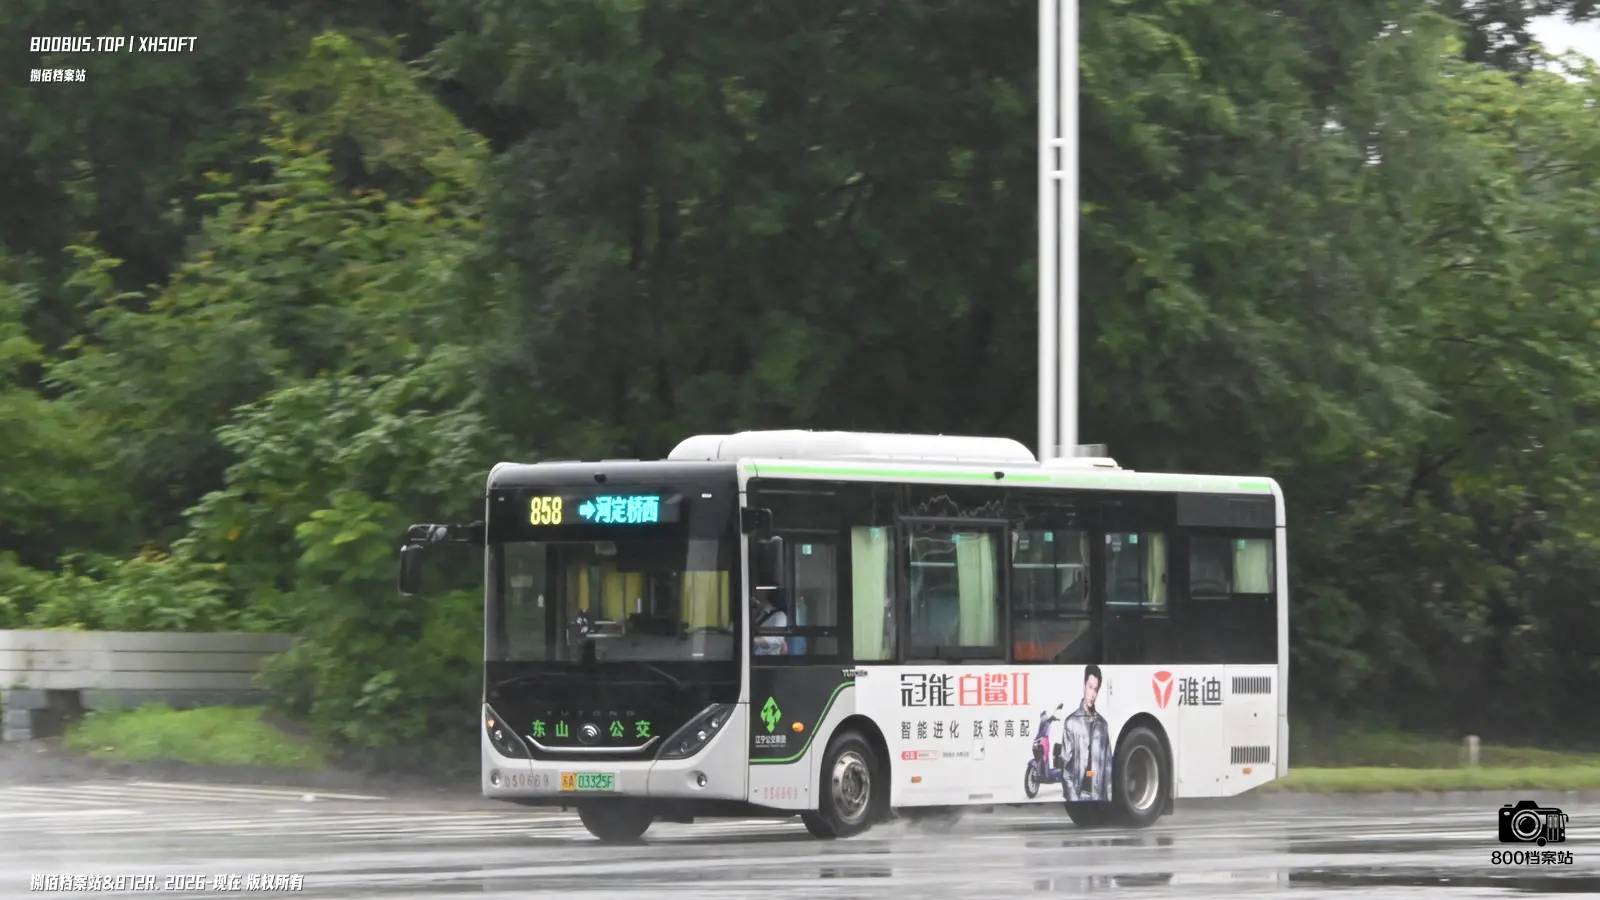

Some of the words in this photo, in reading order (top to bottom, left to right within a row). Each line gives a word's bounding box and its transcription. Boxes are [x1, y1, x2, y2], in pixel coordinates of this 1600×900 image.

[530, 496, 562, 525] 858
[595, 495, 660, 523] 河定桥西
[1178, 676, 1223, 706] 雅迪
